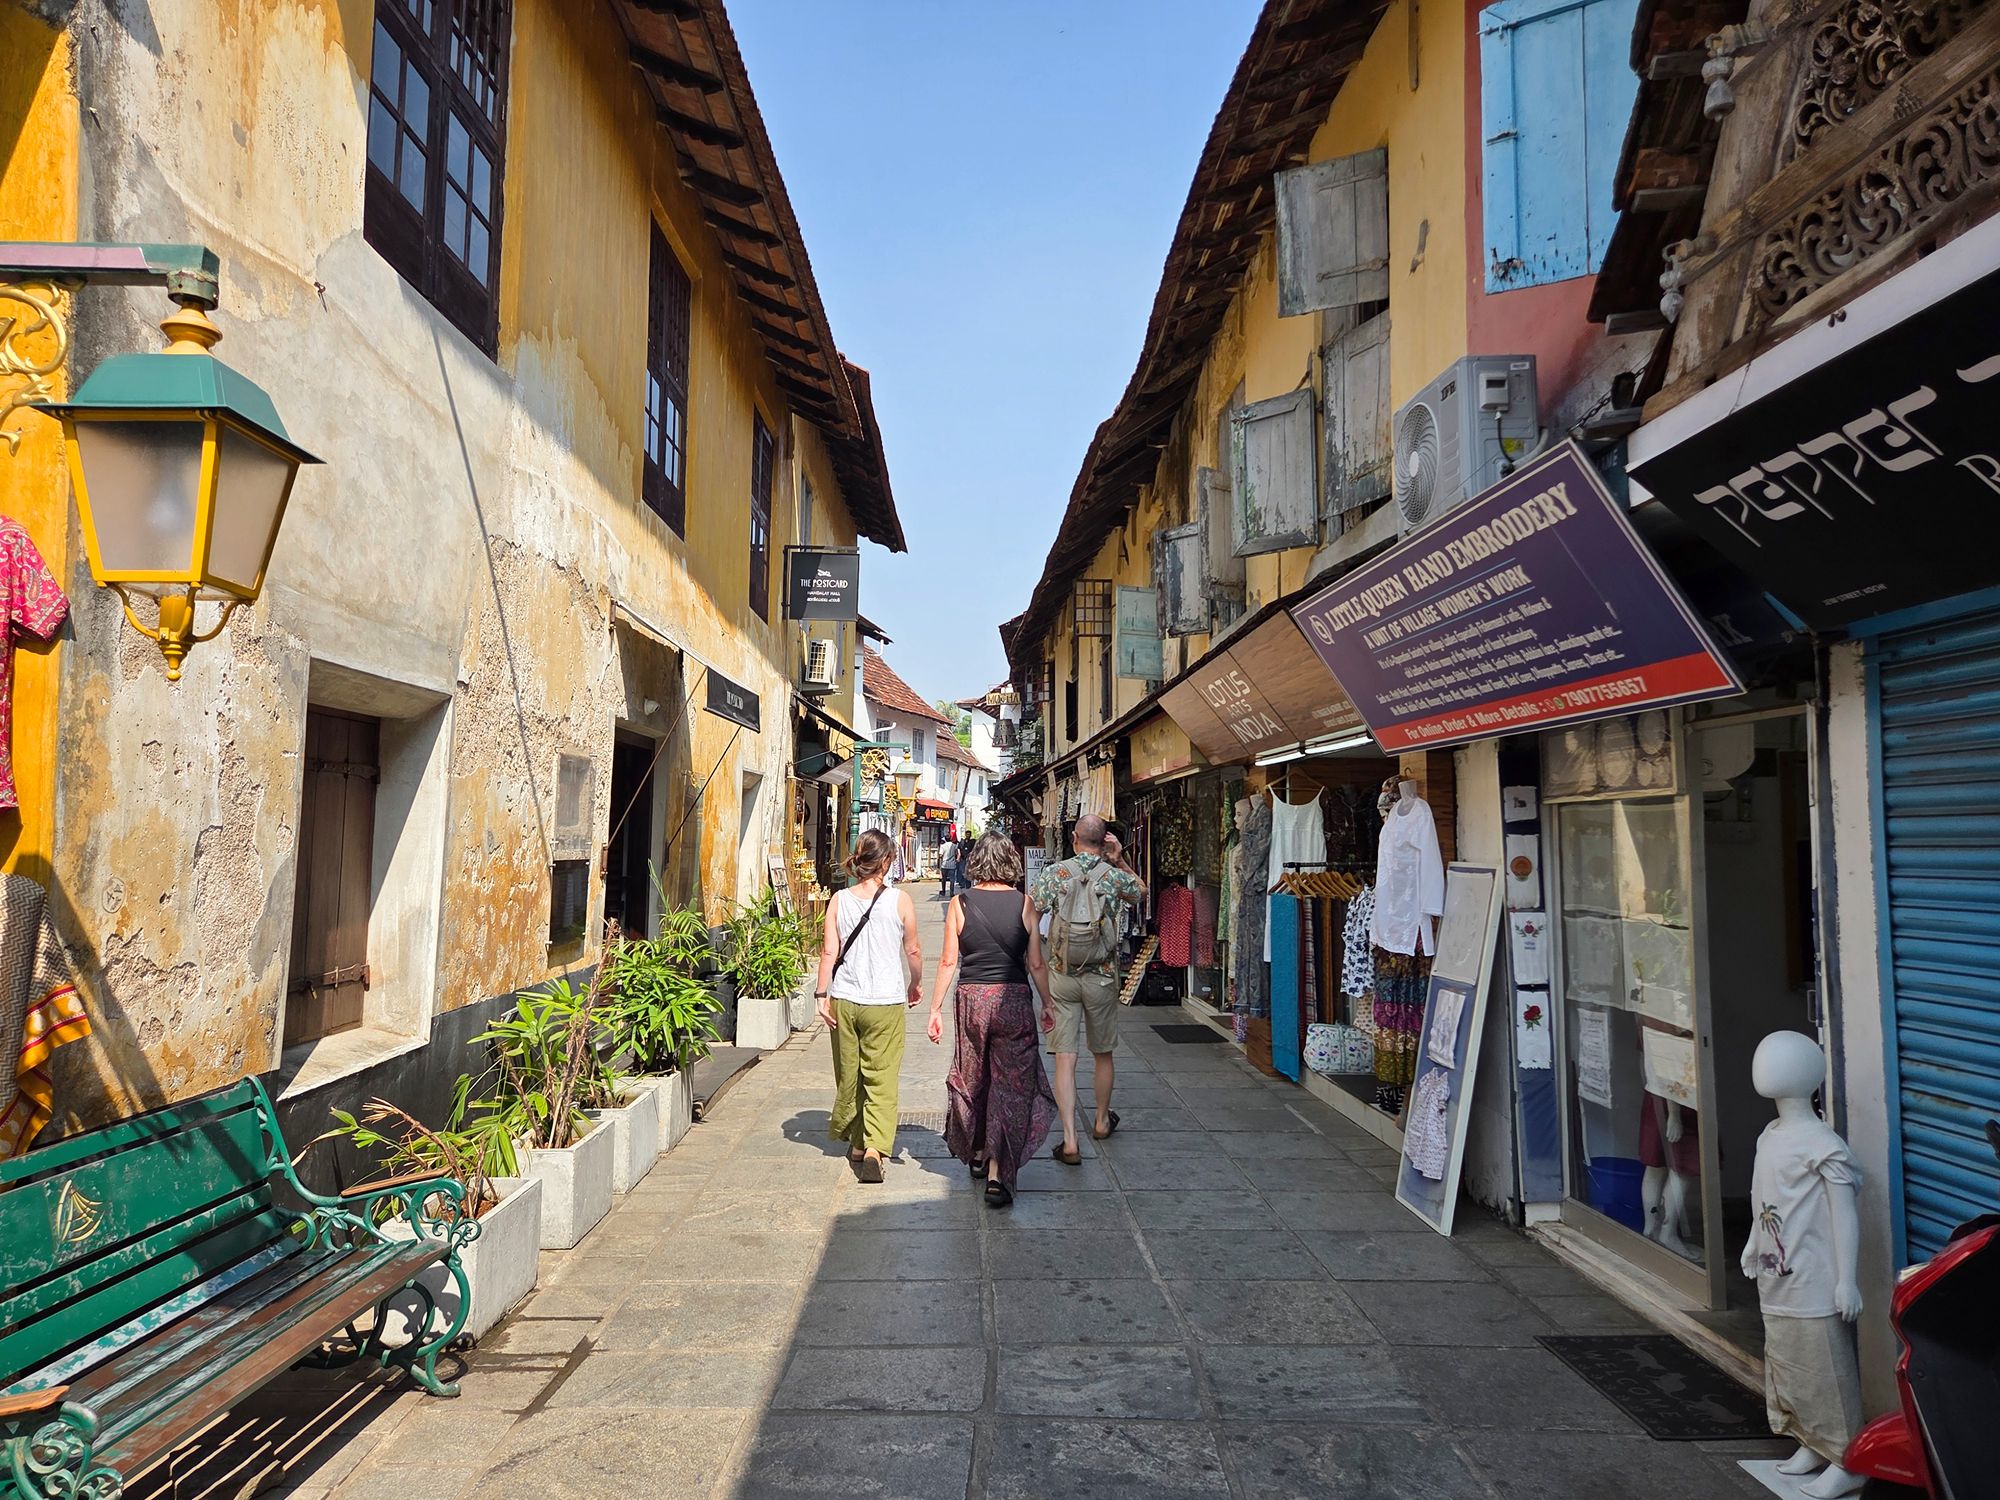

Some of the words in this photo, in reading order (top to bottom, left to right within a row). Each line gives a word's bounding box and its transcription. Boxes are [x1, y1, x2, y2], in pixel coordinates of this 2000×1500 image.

[1325, 596, 1368, 631] LITTLE
[1360, 574, 1408, 617] QUEEN
[1403, 551, 1453, 591] HAND
[1446, 483, 1576, 569] EMBROIDERY
[800, 579, 811, 588] THE
[812, 579, 849, 589] POSTCARD
[1363, 635, 1375, 649] A
[1369, 626, 1392, 646] UNIT
[1388, 621, 1403, 638] OF
[1399, 605, 1441, 633] VILLAGE
[1435, 583, 1491, 617] WOMEN'S
[1486, 565, 1531, 595] WORK
[1200, 670, 1250, 708] LOTUS
[1227, 699, 1252, 719] ARTS
[1404, 728, 1420, 740] For
[1417, 724, 1445, 737] Online
[1442, 718, 1468, 732] Order
[1466, 715, 1478, 727] &
[1474, 712, 1503, 725] More
[1499, 702, 1540, 720] Details
[1561, 676, 1647, 706] 7907755657
[1230, 711, 1283, 744] INDIA
[1028, 849, 1047, 859] MALA
